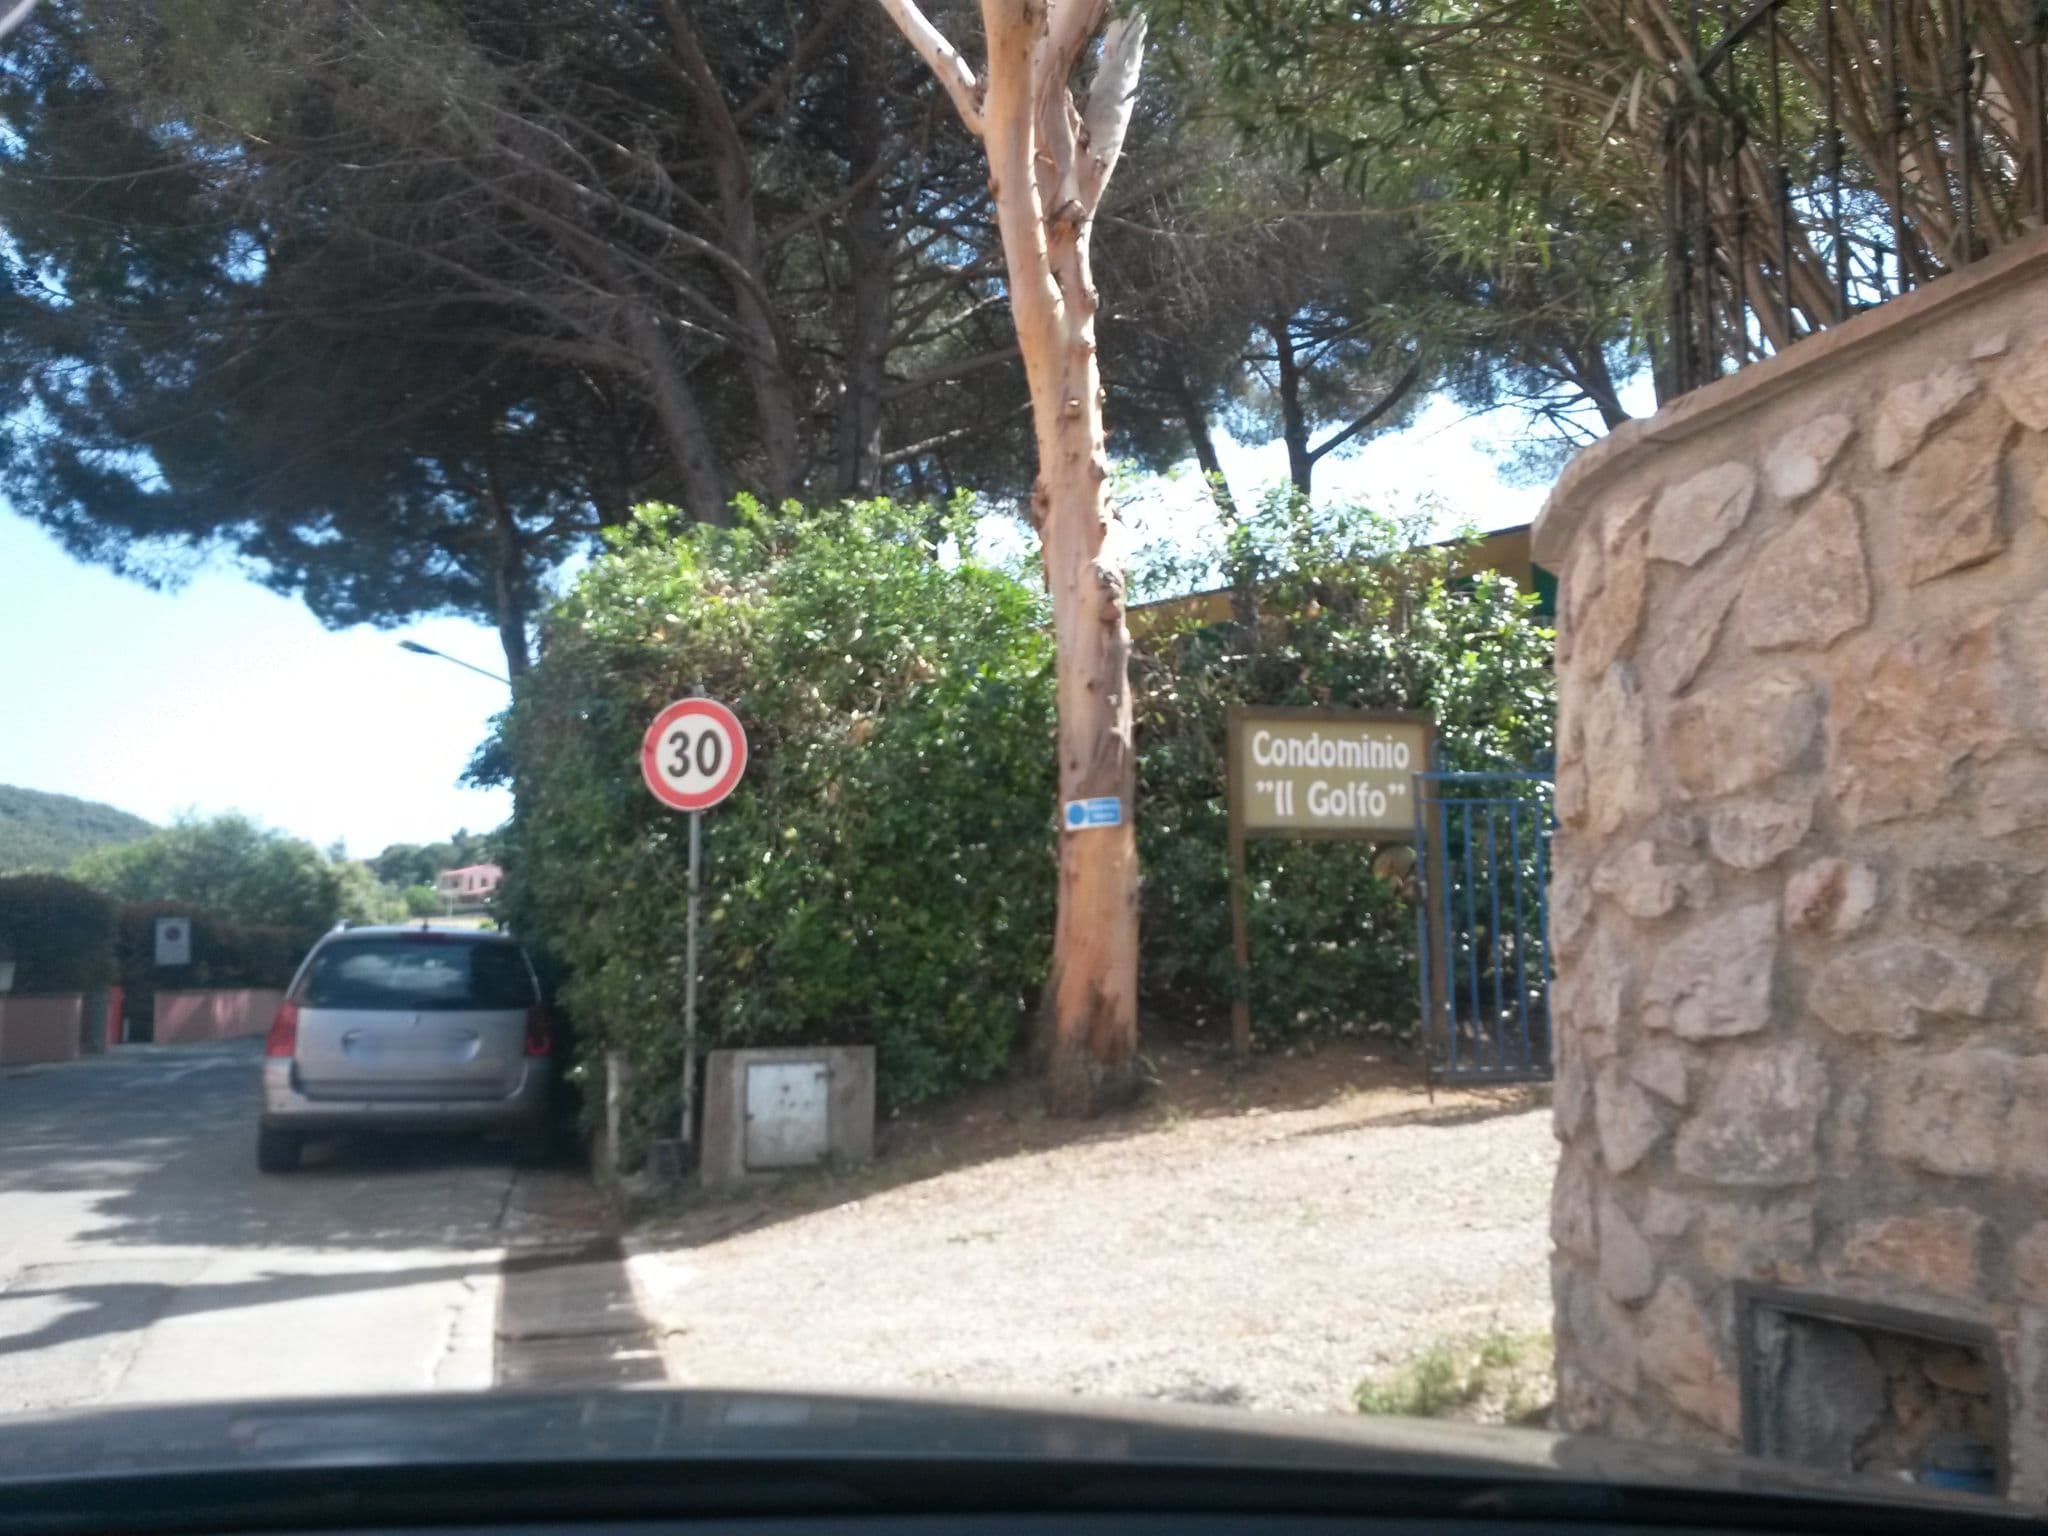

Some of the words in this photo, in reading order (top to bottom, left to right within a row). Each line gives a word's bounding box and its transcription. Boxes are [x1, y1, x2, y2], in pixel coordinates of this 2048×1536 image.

[668, 729, 722, 777] 30
[1252, 730, 1410, 769] Condominio
[1307, 780, 1406, 817] Golfo"
